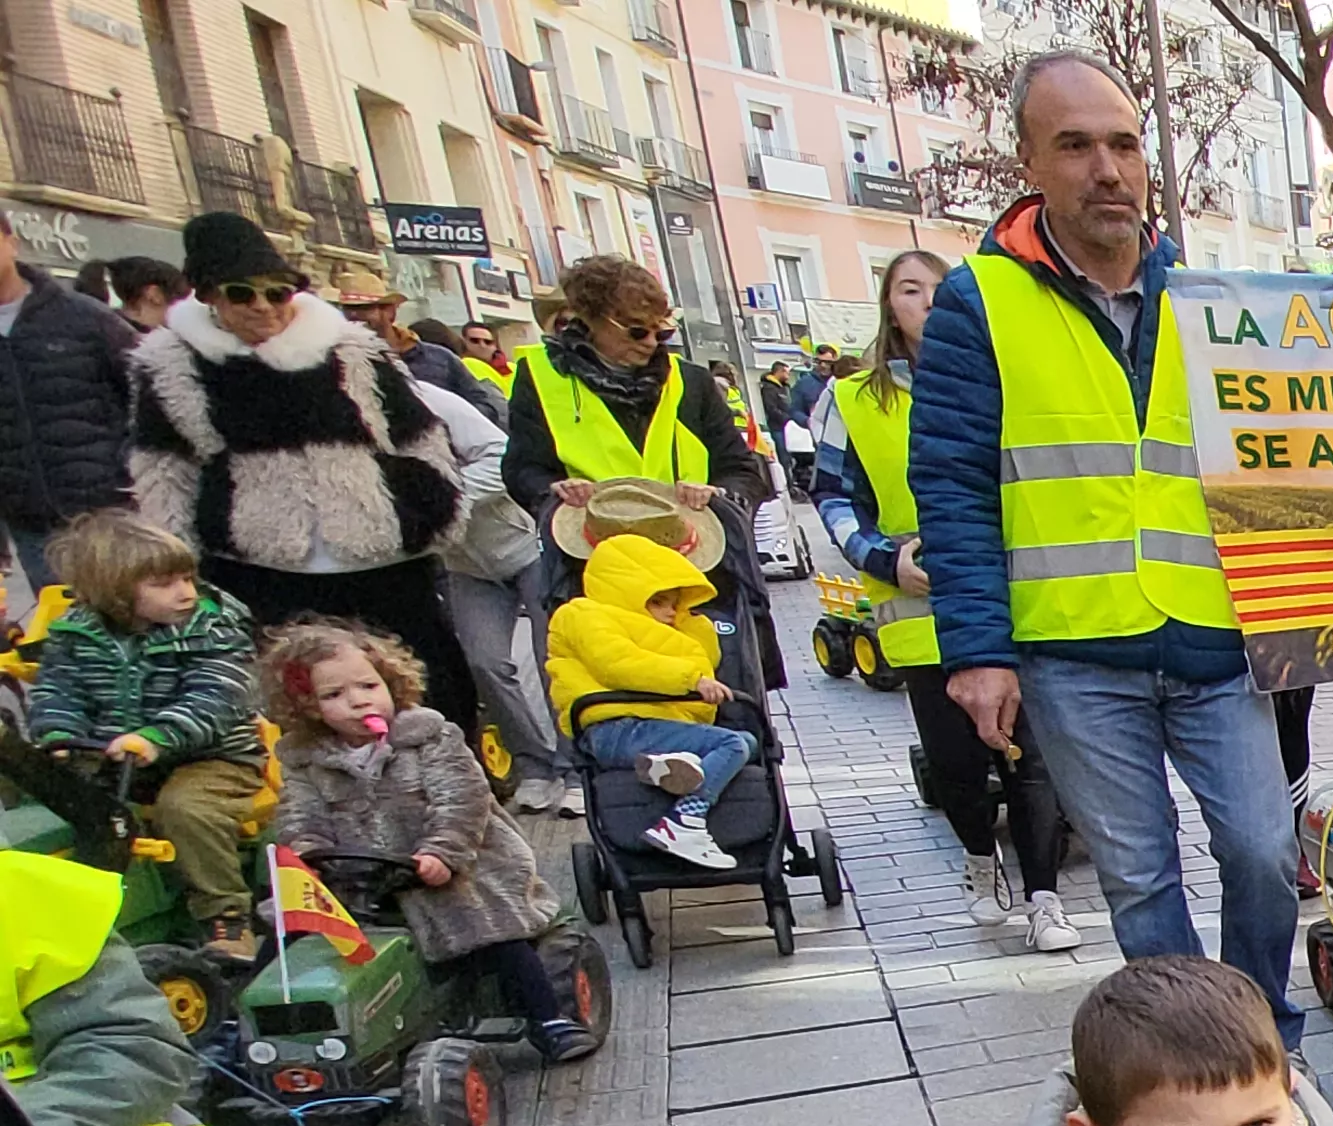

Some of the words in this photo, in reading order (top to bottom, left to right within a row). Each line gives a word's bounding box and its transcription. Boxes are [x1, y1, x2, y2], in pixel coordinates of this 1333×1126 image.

[395, 217, 484, 242] Arenas
[1203, 305, 1268, 346] LA
[1215, 373, 1269, 412] ES
[1234, 434, 1289, 469] SE
